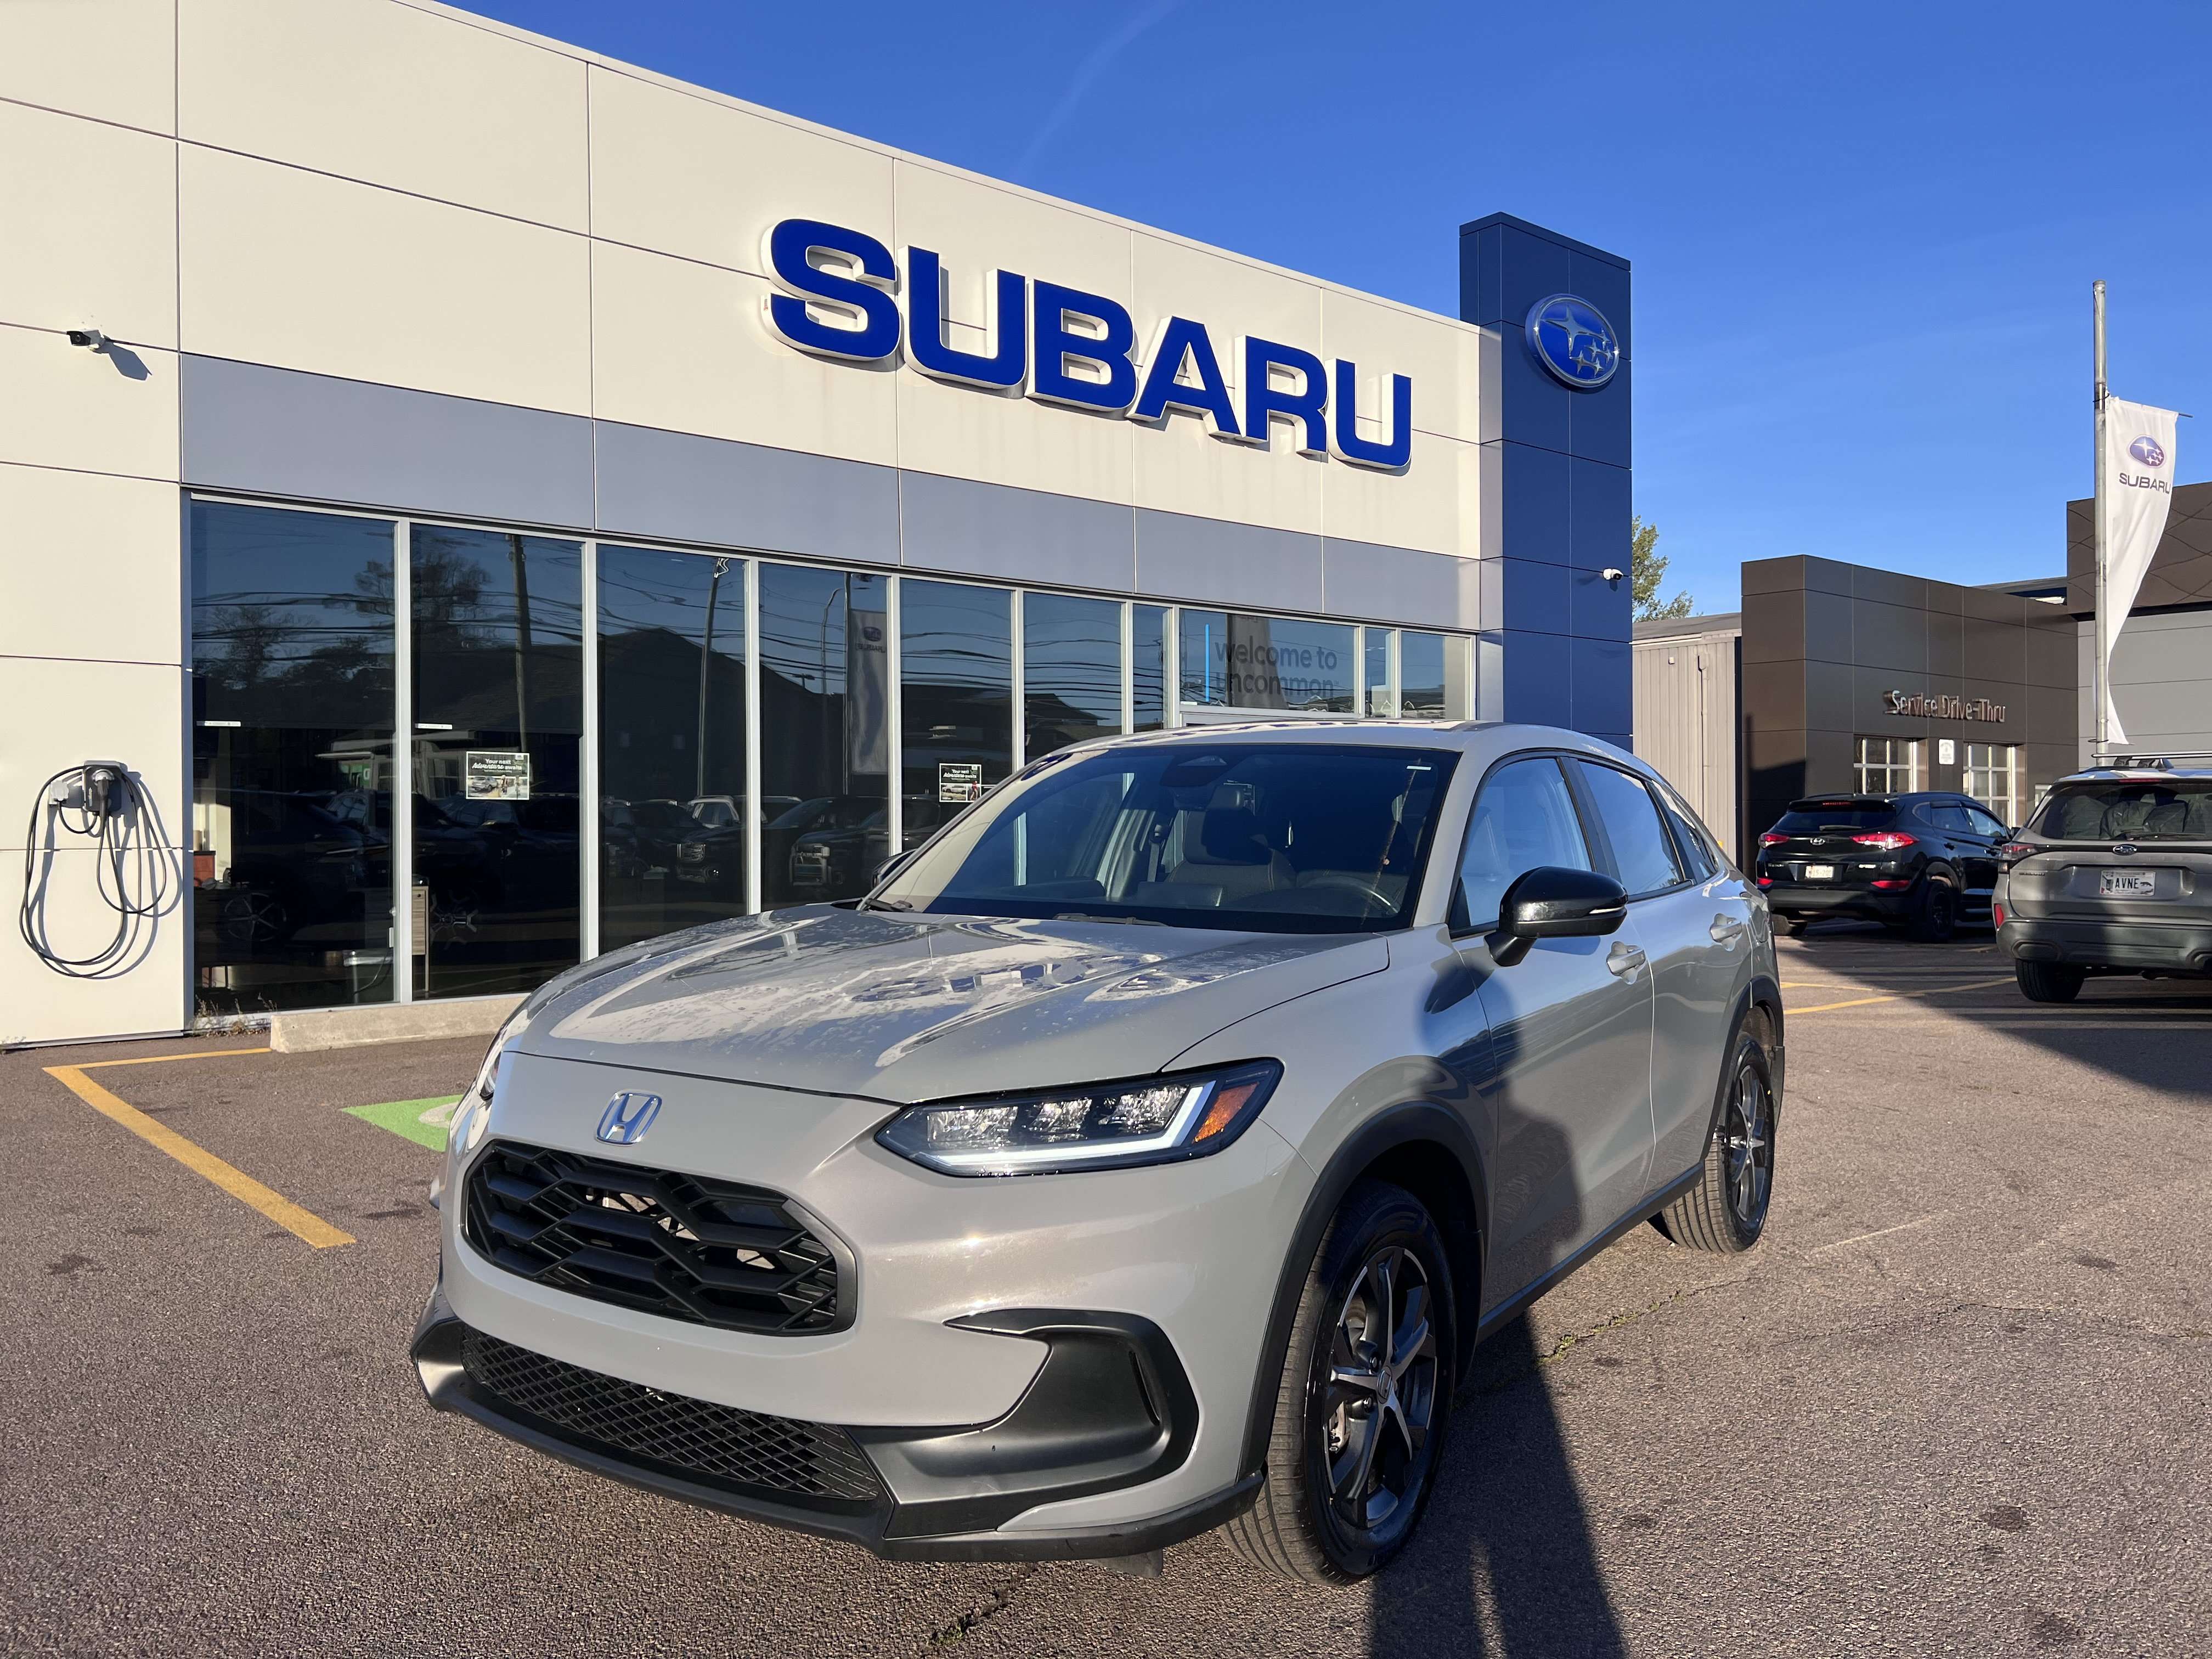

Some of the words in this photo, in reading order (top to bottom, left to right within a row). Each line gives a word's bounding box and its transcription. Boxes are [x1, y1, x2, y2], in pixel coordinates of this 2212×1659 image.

[768, 218, 1412, 470] SUBARU
[2119, 472, 2171, 494] SUBARU
[1215, 635, 1312, 668] welcome
[1317, 646, 1338, 670] to
[1884, 690, 1938, 716] Service
[1941, 695, 2006, 723] Drive-Thru
[2115, 878, 2140, 889] AVNE
